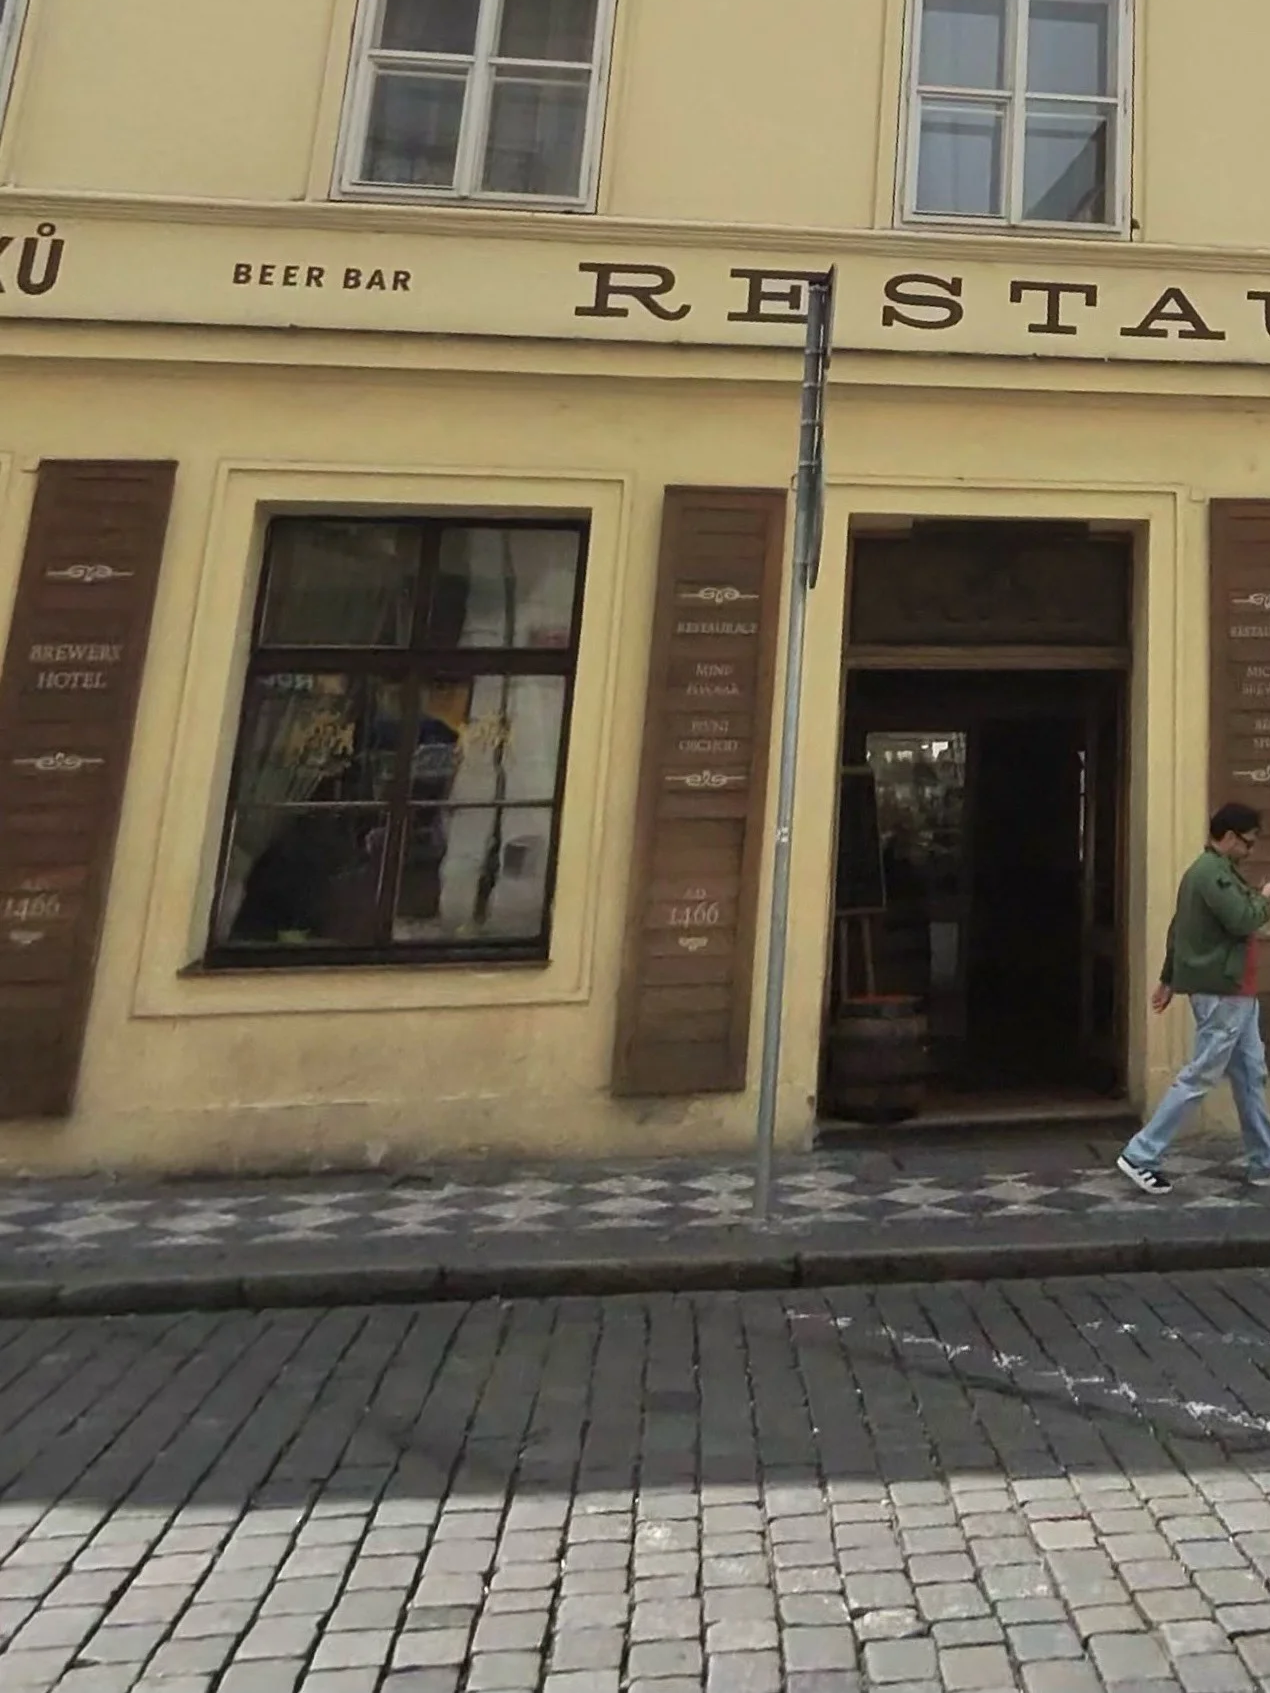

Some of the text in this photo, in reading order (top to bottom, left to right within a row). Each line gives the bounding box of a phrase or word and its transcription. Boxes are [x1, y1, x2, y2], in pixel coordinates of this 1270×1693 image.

[233, 263, 412, 292] BEER BAR
[28, 643, 125, 663] BREWERY
[36, 671, 107, 690] HOTEL
[668, 901, 720, 929] 1466
